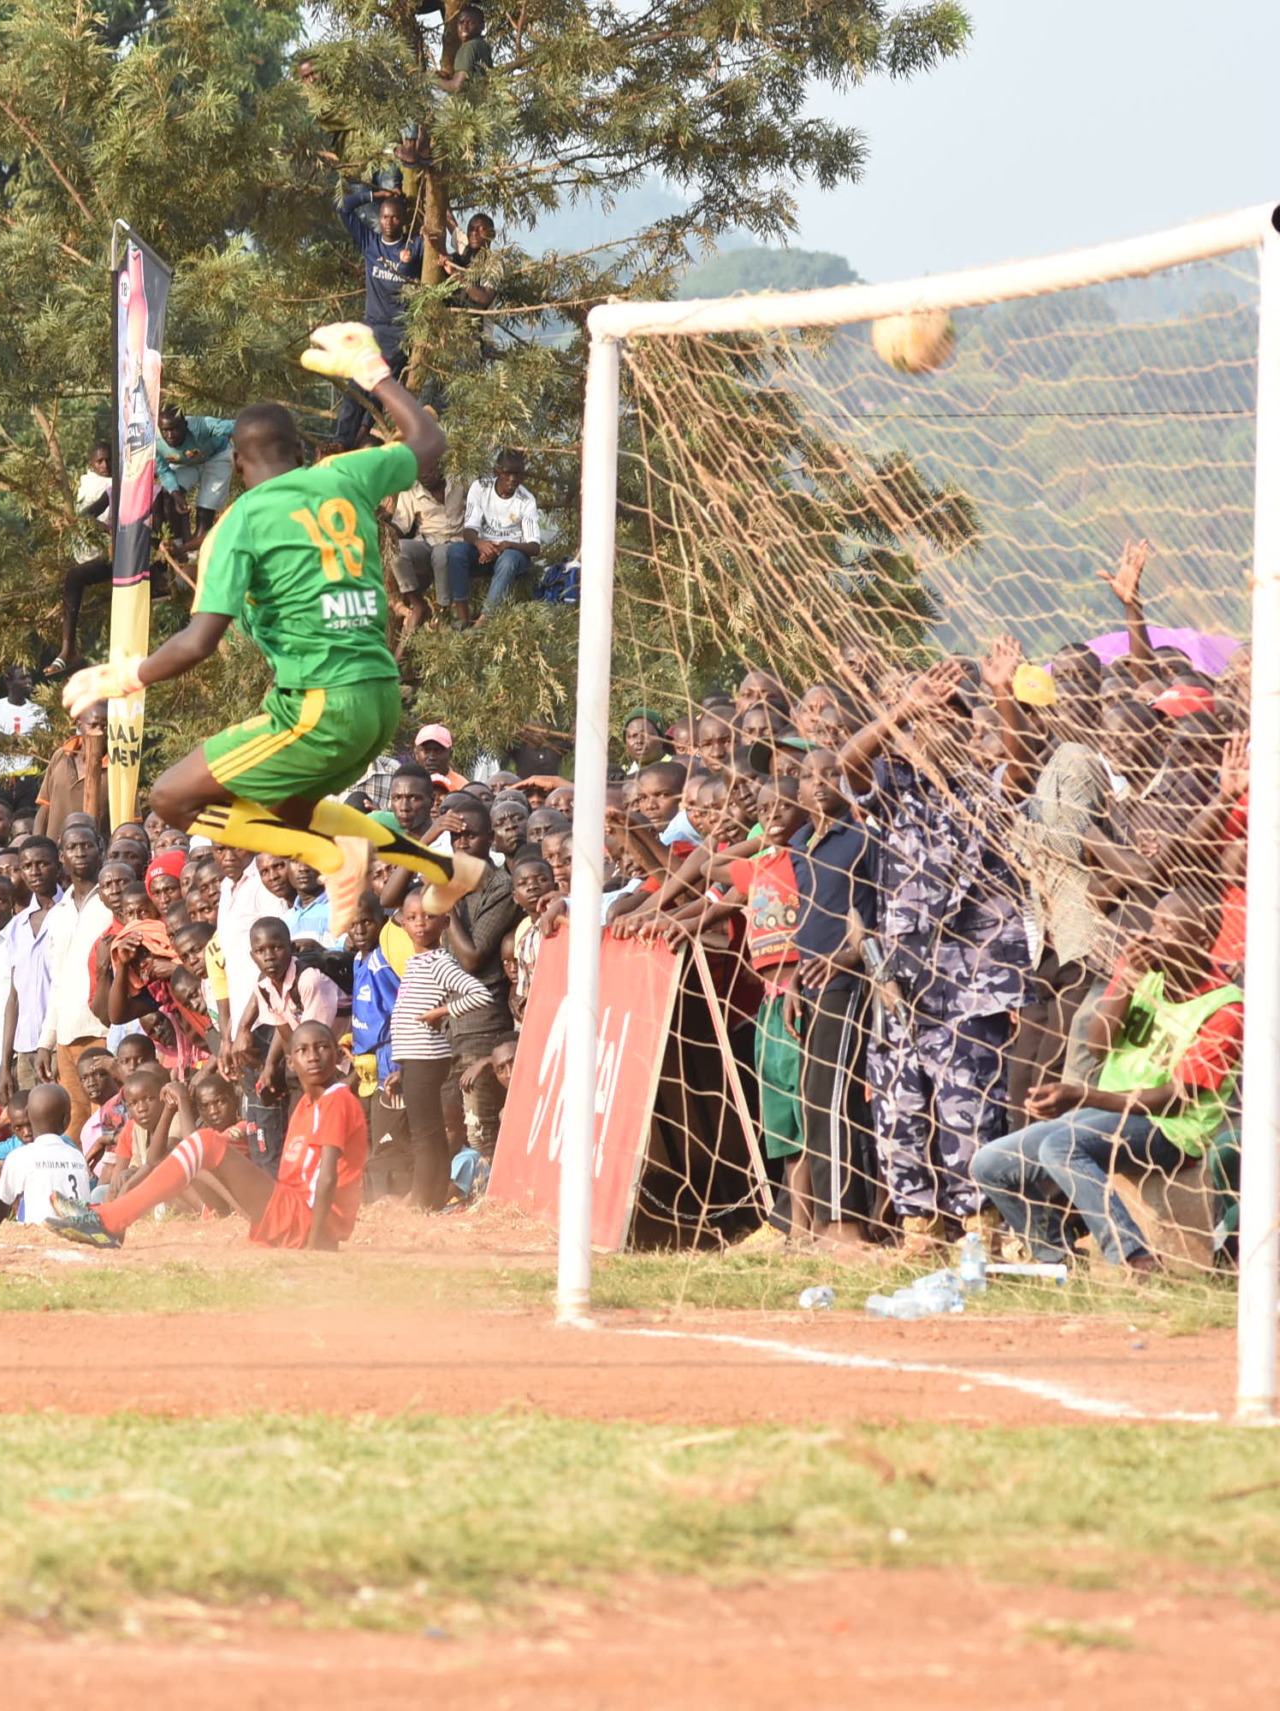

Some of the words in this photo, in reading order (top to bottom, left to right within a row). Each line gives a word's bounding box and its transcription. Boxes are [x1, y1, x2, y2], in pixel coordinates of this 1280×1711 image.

[289, 497, 365, 581] 18
[321, 590, 378, 619] NILE
[67, 1173, 79, 1201] 3
